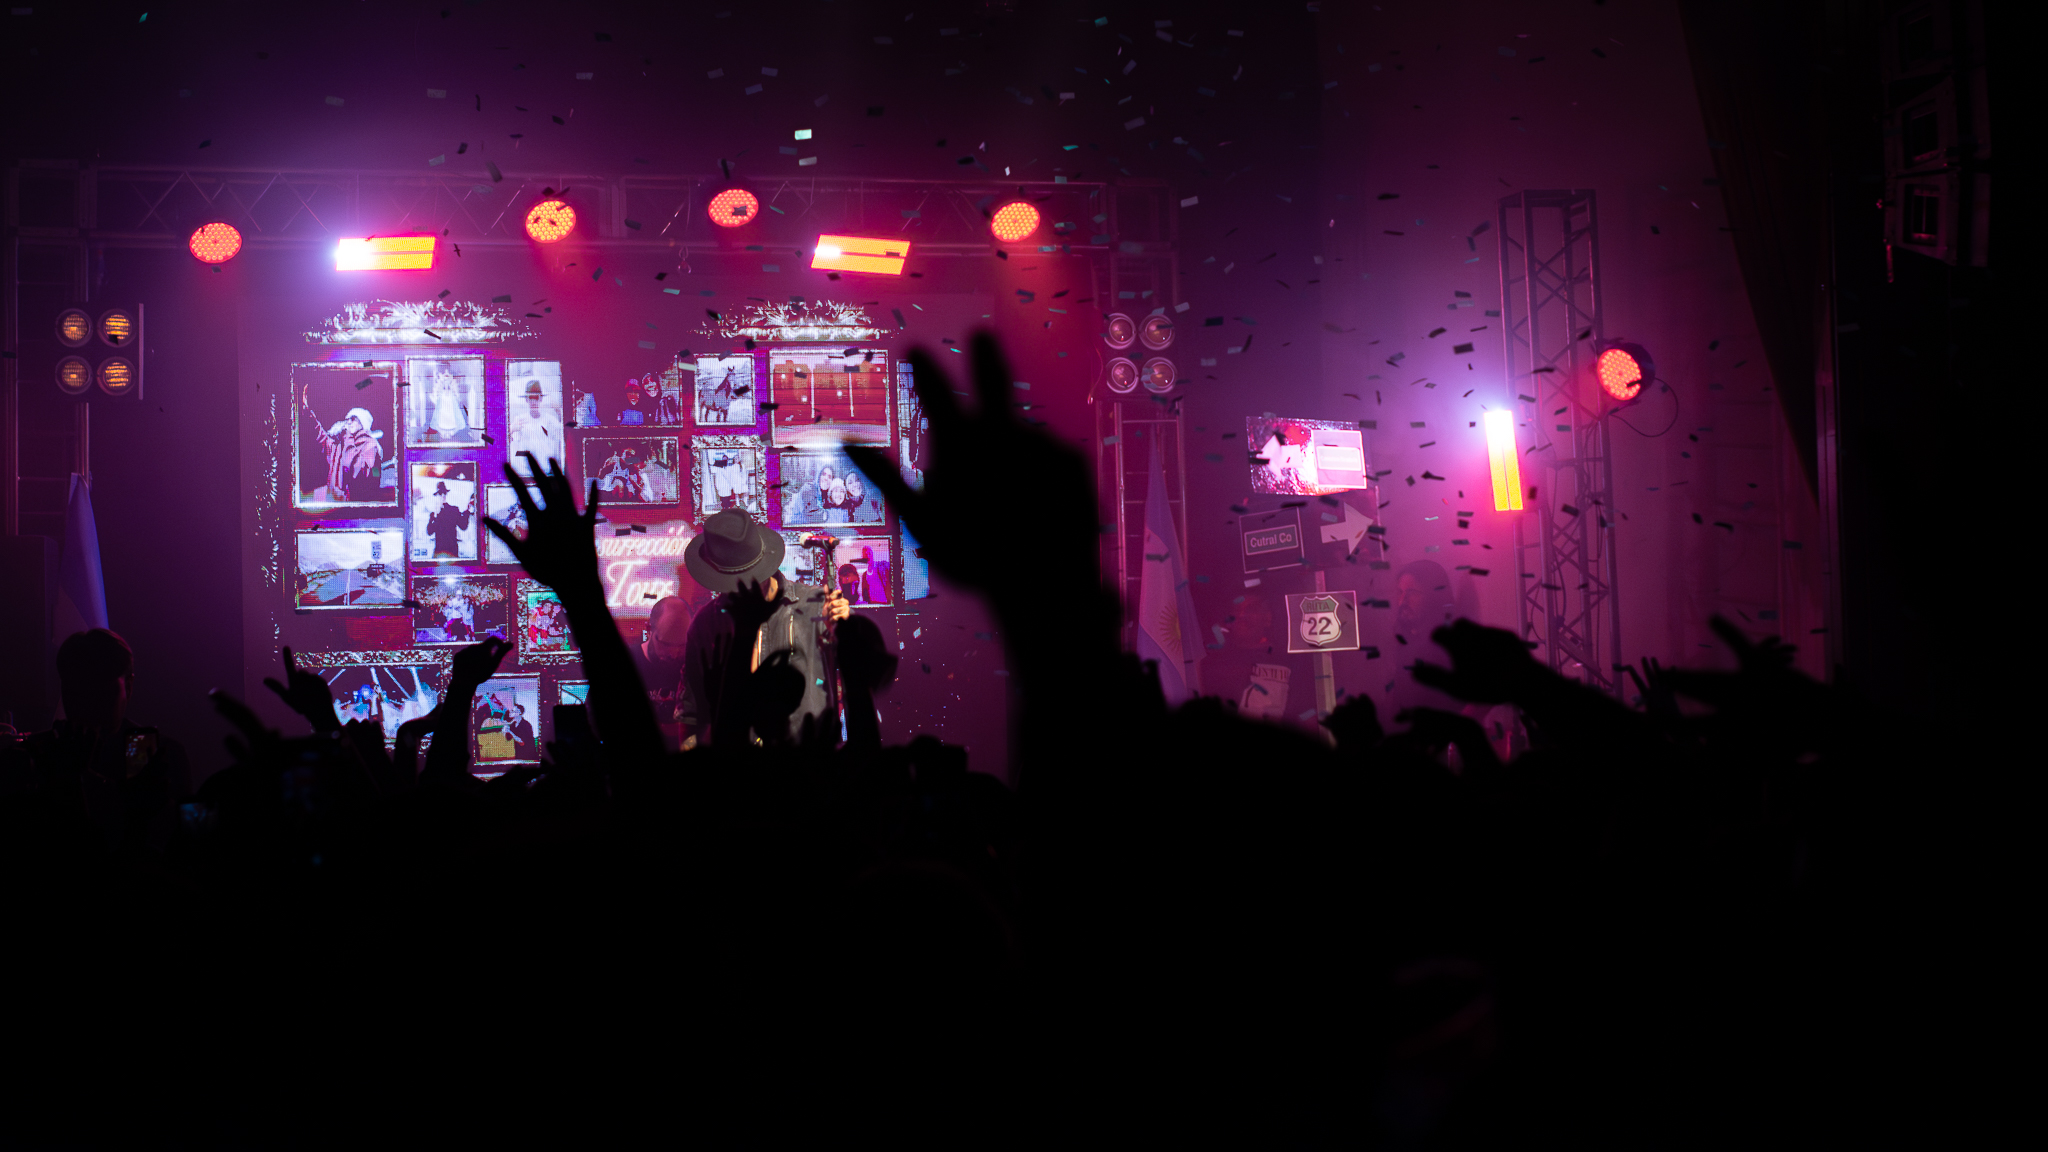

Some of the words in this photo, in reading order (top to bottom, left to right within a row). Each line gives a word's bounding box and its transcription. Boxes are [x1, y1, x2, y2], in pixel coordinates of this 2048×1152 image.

[596, 525, 692, 556] surrección
[1250, 533, 1277, 548] Cutral
[1279, 532, 1292, 544] Co
[1306, 601, 1330, 611] RUTA
[1308, 616, 1332, 635] 22
